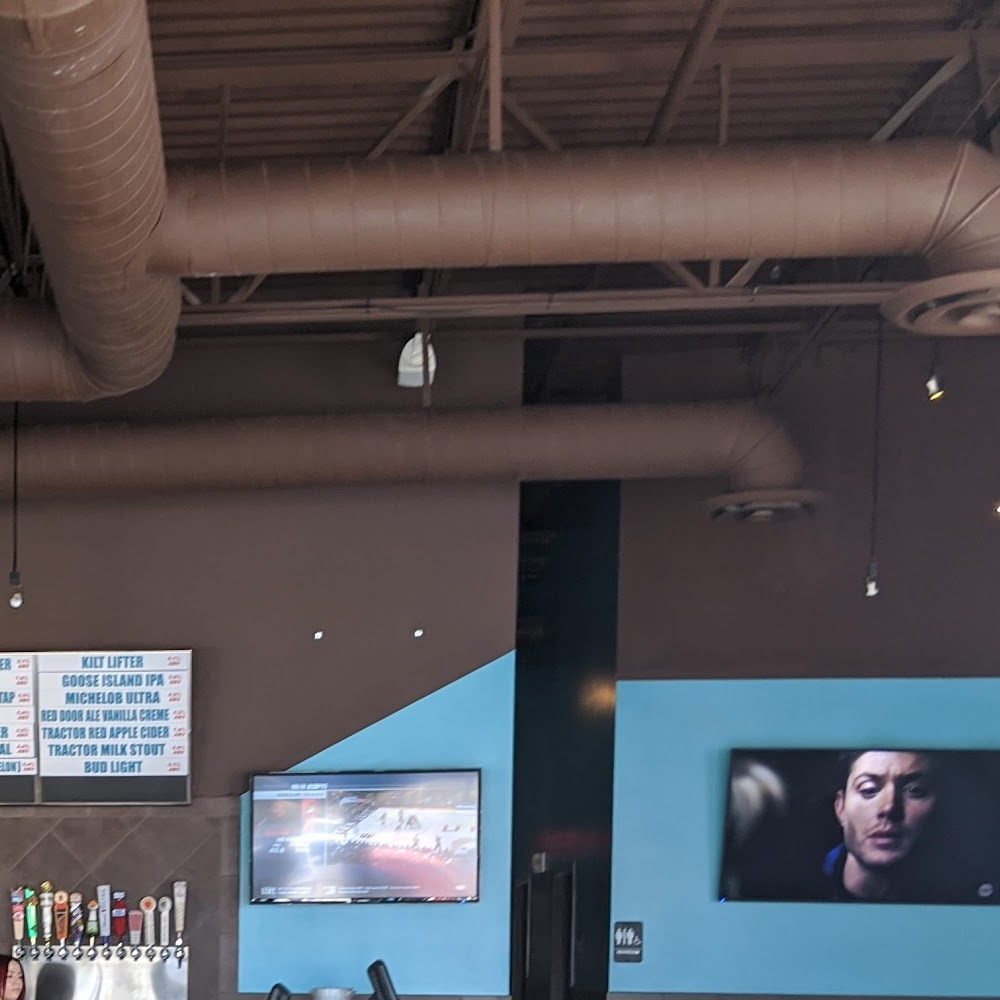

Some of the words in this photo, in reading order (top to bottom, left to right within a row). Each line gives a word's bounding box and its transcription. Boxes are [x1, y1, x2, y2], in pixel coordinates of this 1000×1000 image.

[82, 656, 104, 668] KILT
[108, 656, 143, 668] LIFTER
[62, 674, 99, 687] GOOSE
[102, 674, 142, 687] ISLAND
[146, 674, 164, 687] IPA
[65, 692, 122, 704] MICHELOB
[126, 692, 160, 704] ULTRA
[41, 709, 57, 722] RED
[60, 709, 83, 722] DOOR
[85, 709, 100, 722] ALE
[102, 709, 137, 722] VANILLA
[140, 709, 169, 722] CREME
[42, 727, 86, 739] TRACTOR
[89, 727, 106, 739] RED
[109, 727, 138, 739] APPLE
[141, 727, 169, 739] CIDER
[48, 744, 97, 756] TRACTOR
[101, 744, 127, 756] MILK
[130, 744, 165, 756] STOUT
[84, 761, 107, 773] BUD
[110, 761, 142, 773] LIGHT
